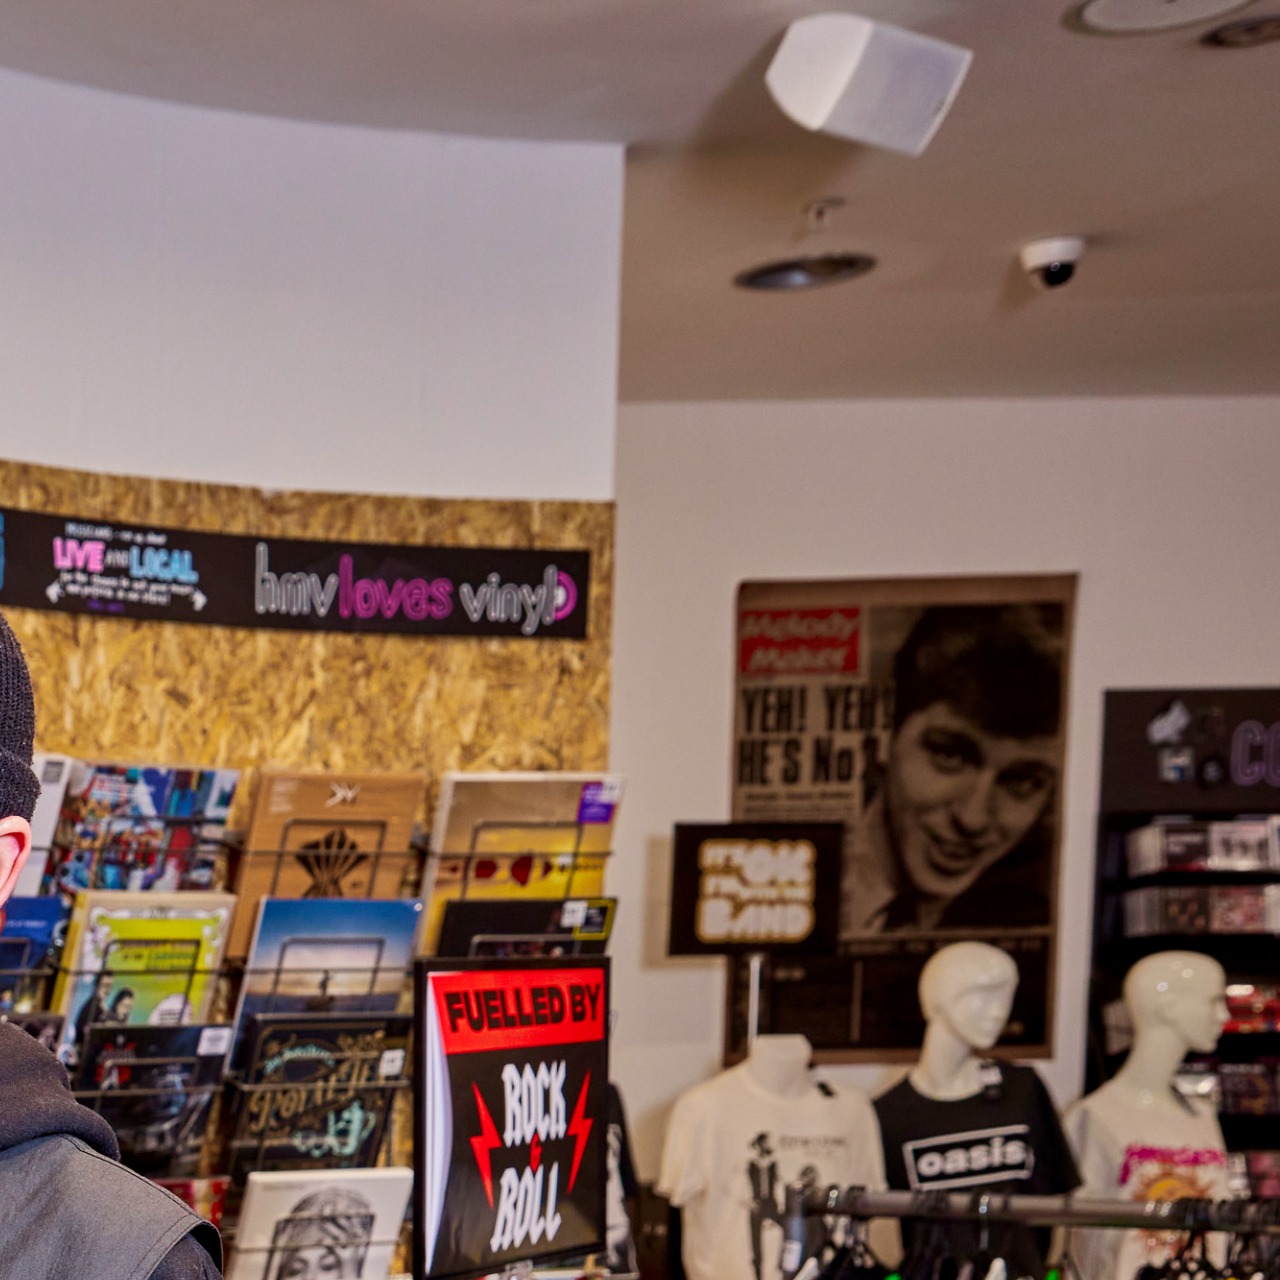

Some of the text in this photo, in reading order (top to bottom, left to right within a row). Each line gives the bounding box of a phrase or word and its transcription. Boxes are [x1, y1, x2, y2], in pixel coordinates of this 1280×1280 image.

[53, 537, 106, 572] LIVE
[129, 546, 199, 583] LOCAL
[255, 542, 562, 635] hmv loves vinyl
[741, 611, 857, 641] Melody
[747, 646, 848, 673] Maker
[742, 686, 806, 733] YEH!
[743, 840, 813, 884] OK
[702, 899, 812, 940] BAND
[444, 983, 601, 1033] FUELLED BY
[501, 1059, 567, 1149] ROCK
[914, 1136, 1028, 1178] oasis
[490, 1161, 561, 1254] ROLL
